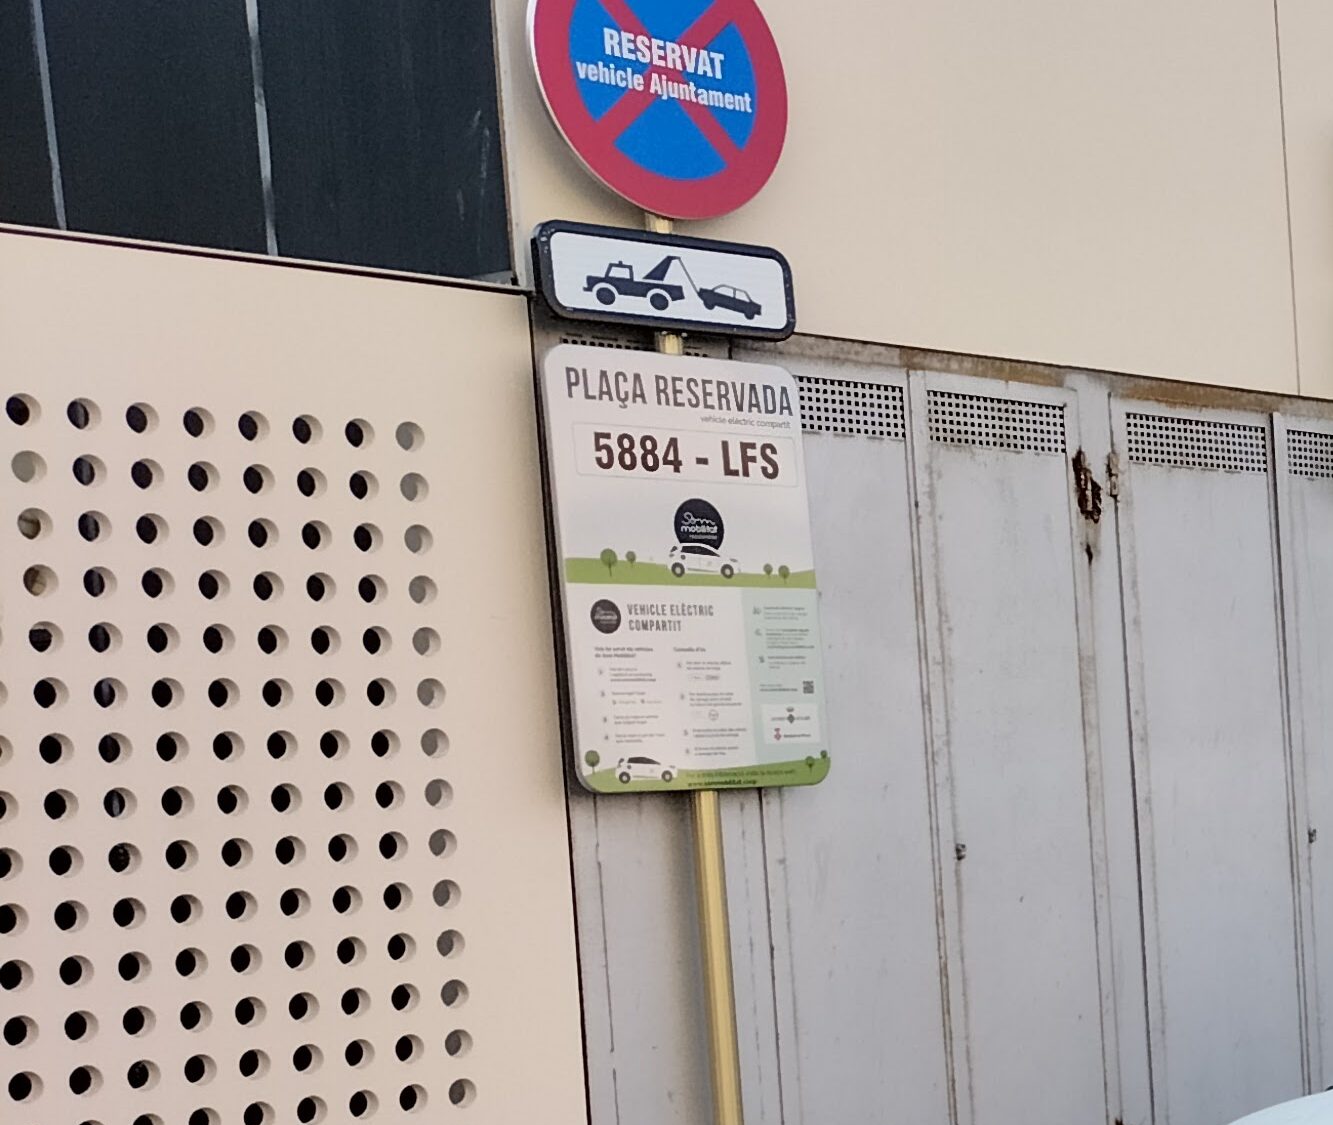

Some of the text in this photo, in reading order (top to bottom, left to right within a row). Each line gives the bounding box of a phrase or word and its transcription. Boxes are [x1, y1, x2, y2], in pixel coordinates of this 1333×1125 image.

[603, 27, 724, 80] RESERVAT
[576, 60, 752, 113] vehicle Ajuntament
[565, 366, 793, 417] PLAÇA RESERVADA
[593, 431, 780, 480] 5884 - LFS
[626, 604, 667, 616] VEHICLE
[628, 619, 682, 631] COMPARTIT
